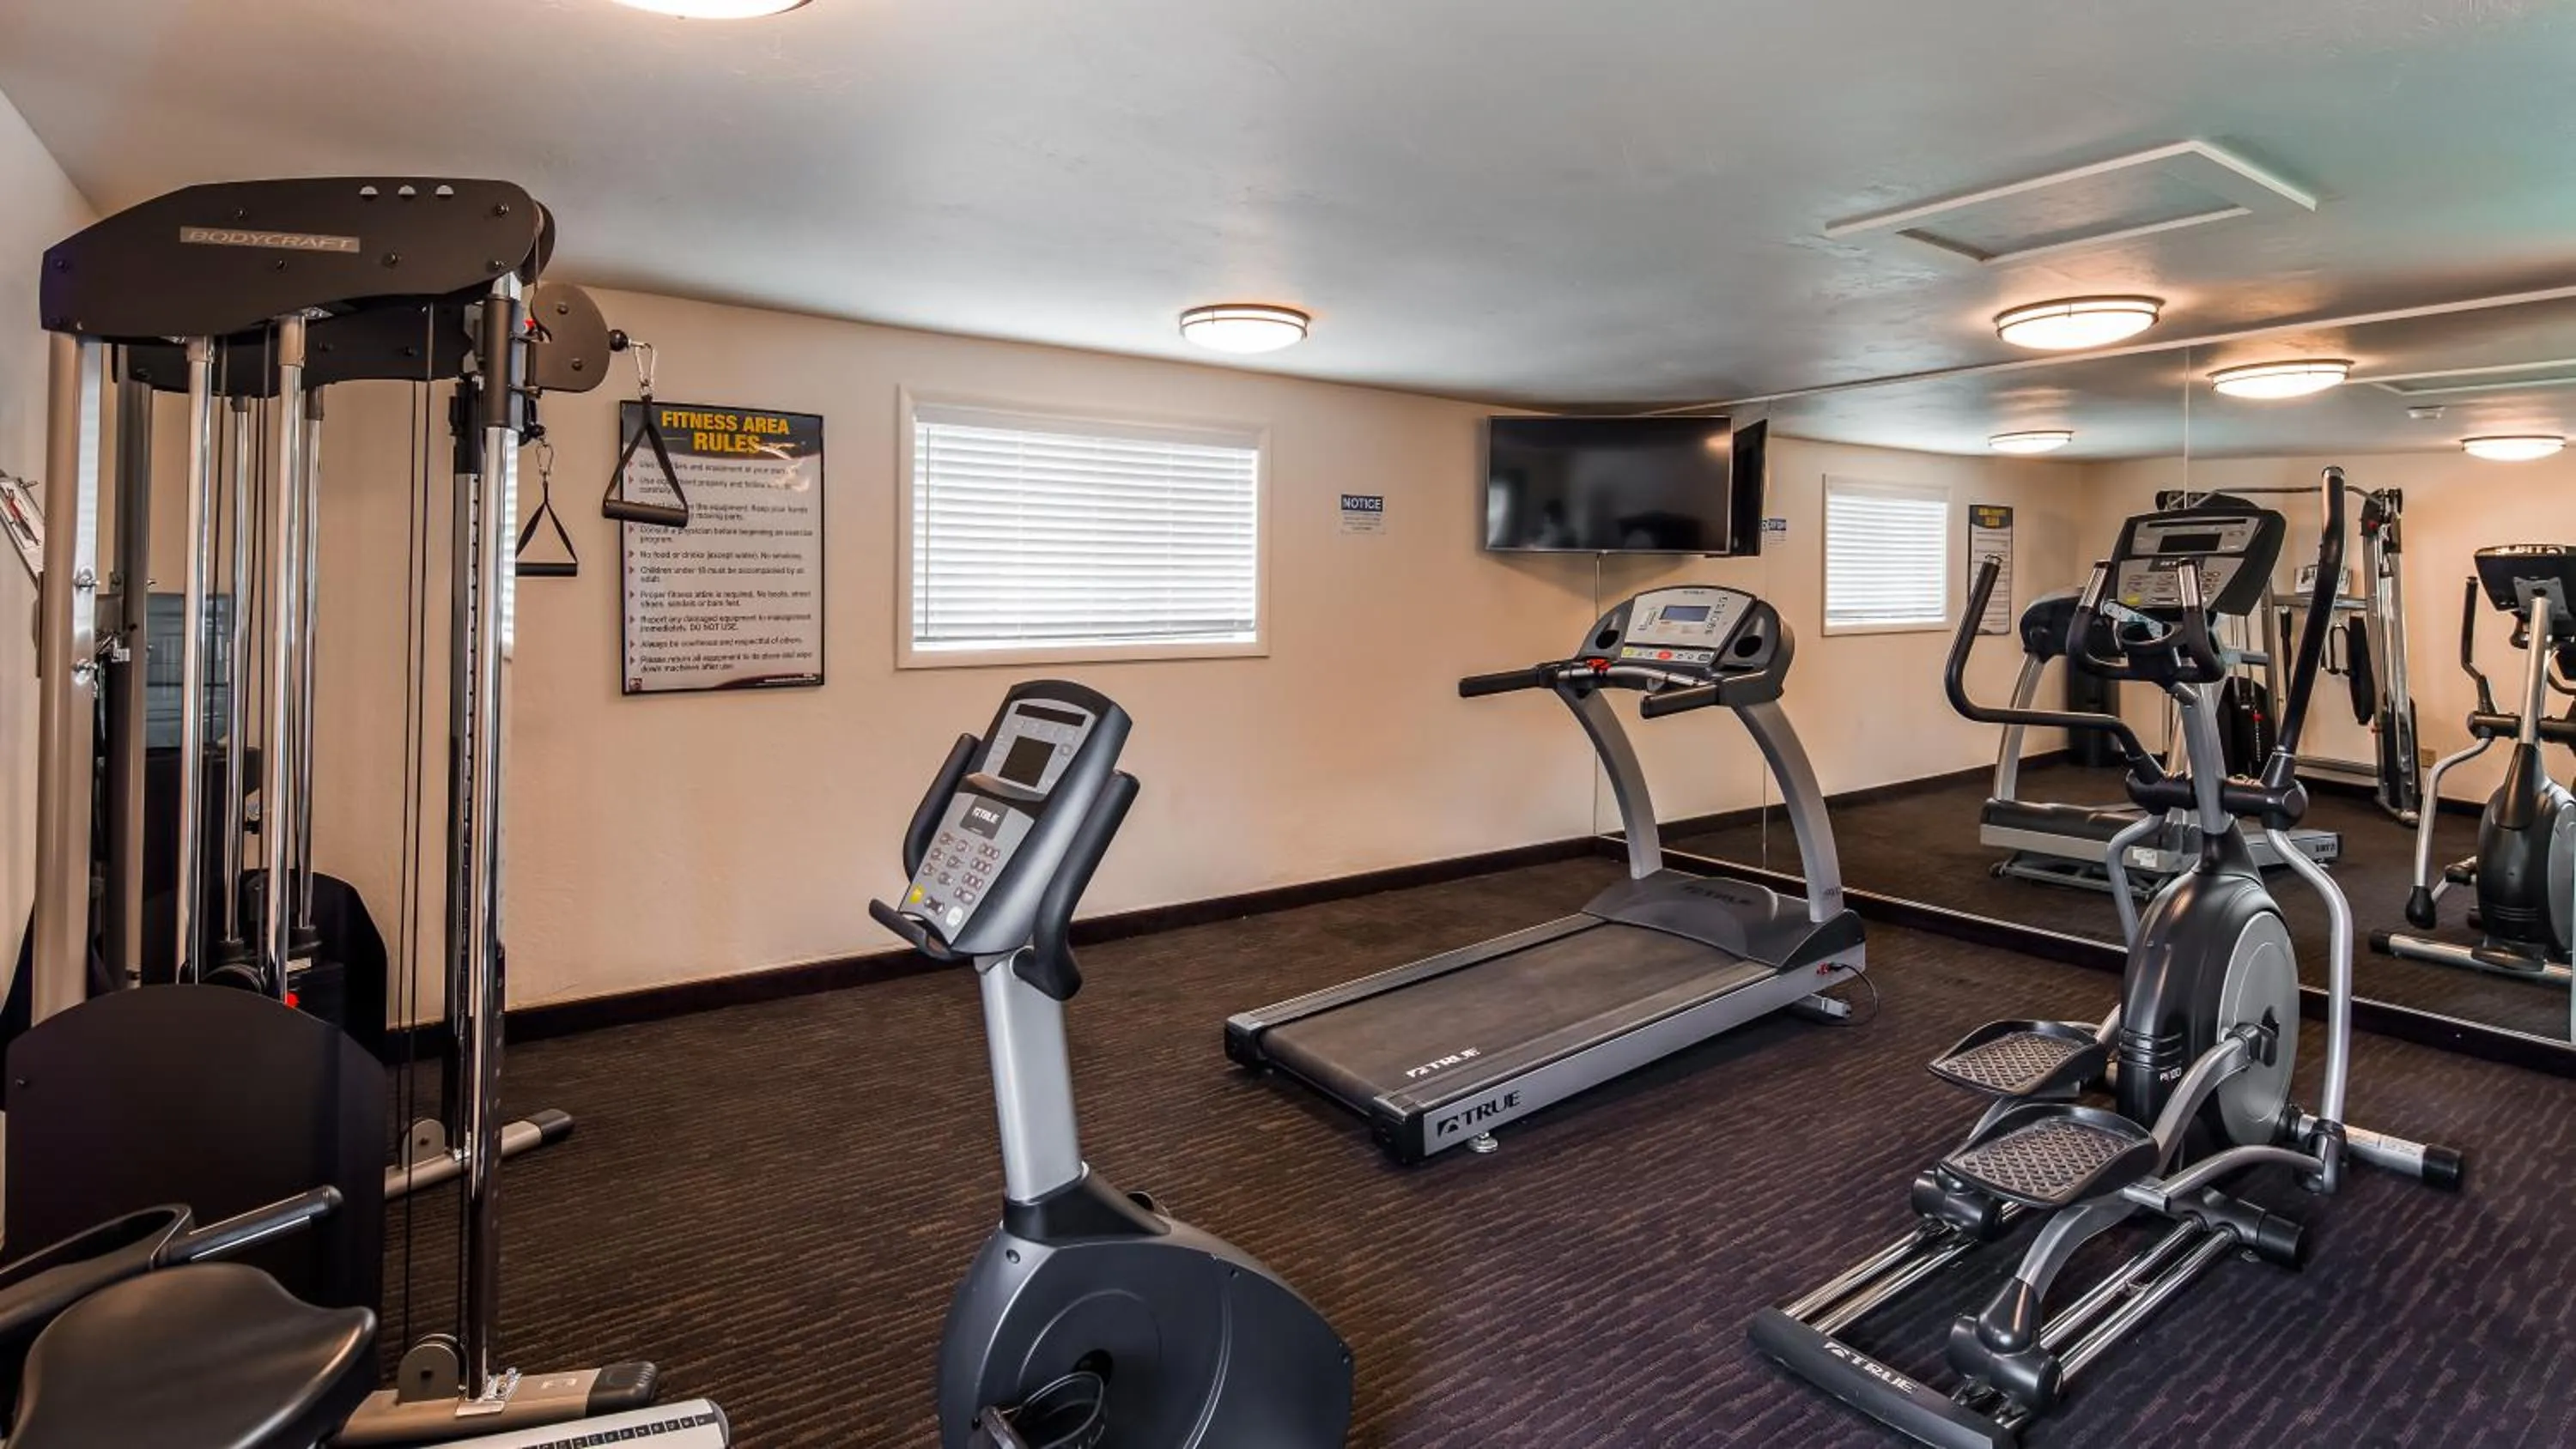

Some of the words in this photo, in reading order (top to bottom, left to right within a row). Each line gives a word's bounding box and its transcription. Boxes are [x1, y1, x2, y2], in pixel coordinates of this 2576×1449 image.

[187, 230, 355, 249] BODYCRAFT
[661, 411, 738, 431] FITNESS
[743, 416, 790, 435] AREA
[693, 432, 762, 454] RULES
[1342, 497, 1382, 509] NOTICE
[640, 566, 672, 574] Children
[690, 622, 702, 631] DO
[702, 622, 720, 631] NOT
[1425, 1046, 1481, 1070] TRUE
[1461, 1089, 1522, 1126] TRUE
[1850, 1351, 1919, 1396] TRUE
